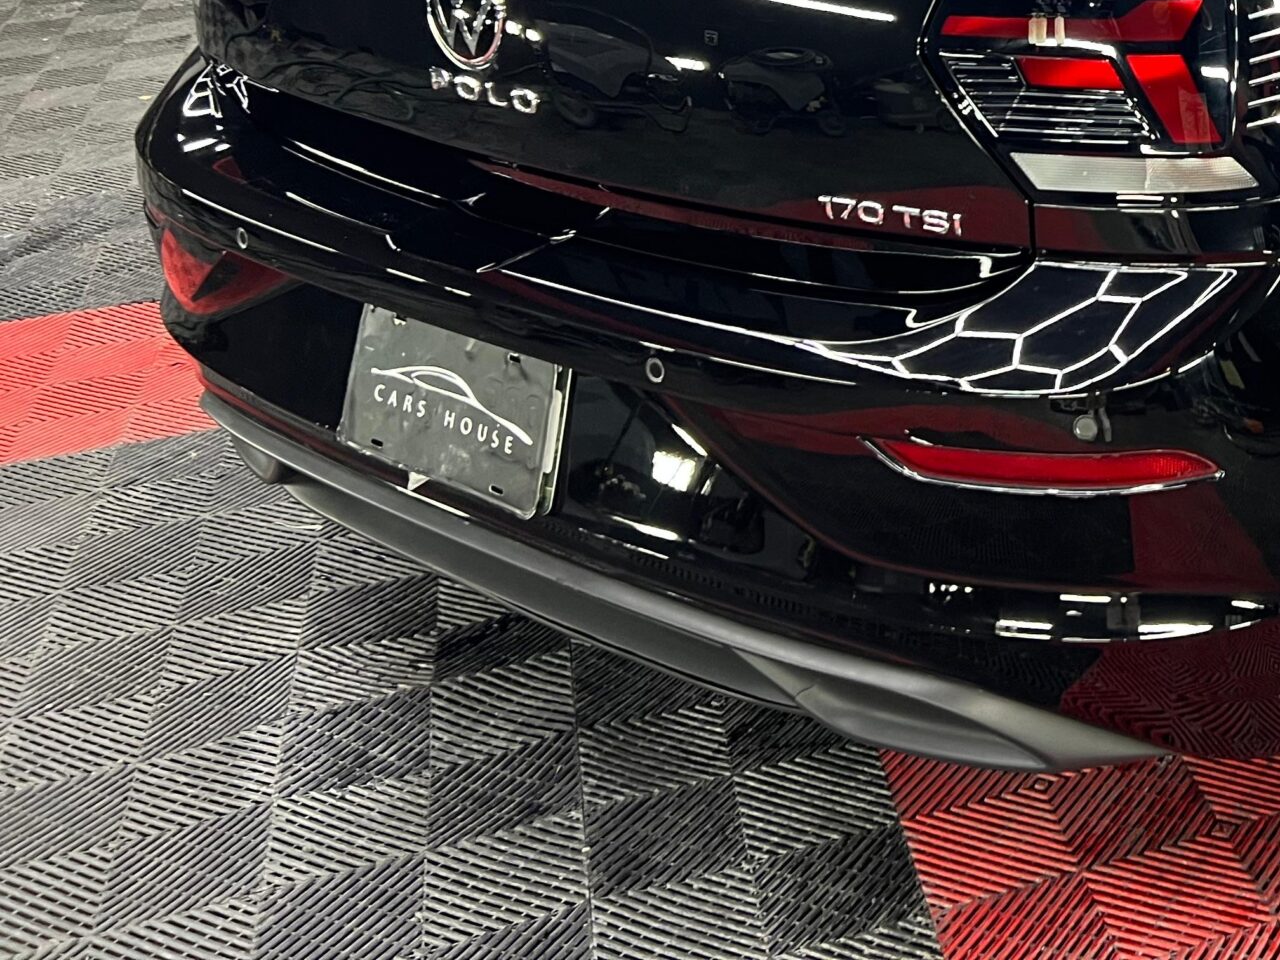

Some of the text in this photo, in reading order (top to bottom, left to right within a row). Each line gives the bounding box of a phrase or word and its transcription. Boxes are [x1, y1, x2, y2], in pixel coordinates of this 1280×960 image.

[429, 66, 540, 114] POLO
[818, 195, 884, 225] 170
[374, 384, 513, 455] CARS HOUSE
